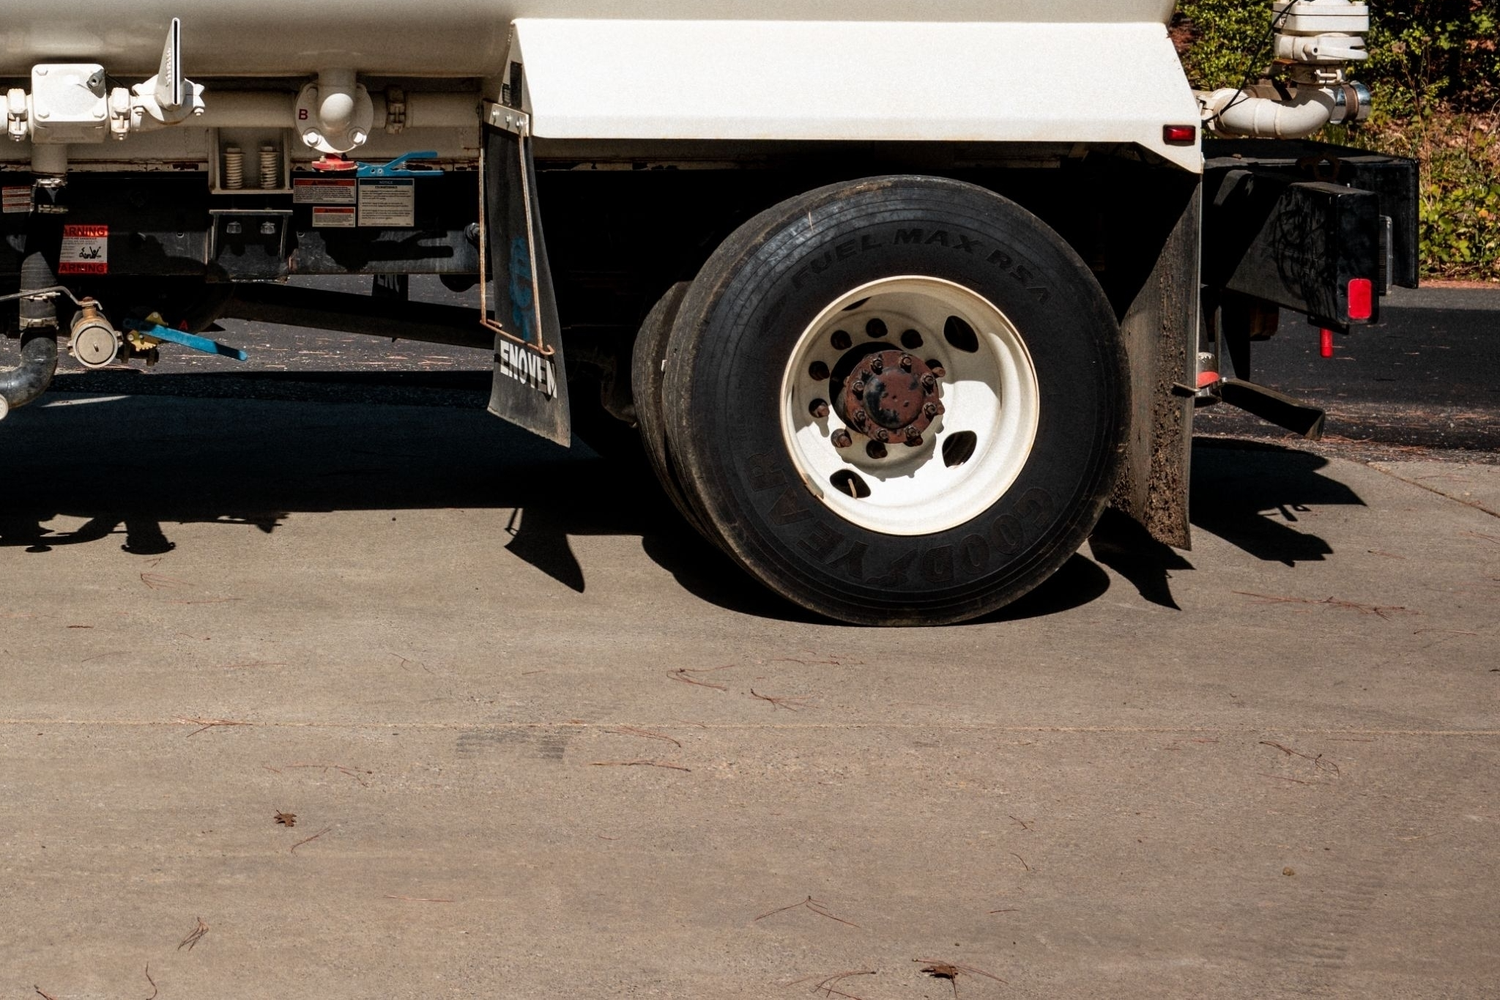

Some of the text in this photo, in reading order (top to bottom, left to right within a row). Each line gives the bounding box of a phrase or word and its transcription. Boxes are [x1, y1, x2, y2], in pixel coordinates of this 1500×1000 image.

[298, 109, 308, 120] B
[63, 226, 105, 237] ARNING
[60, 263, 105, 273] ARNING
[790, 227, 1053, 306] FUEL MAX RSA
[499, 339, 558, 400] ENOVEN
[748, 449, 1056, 583] GOODYEAR
